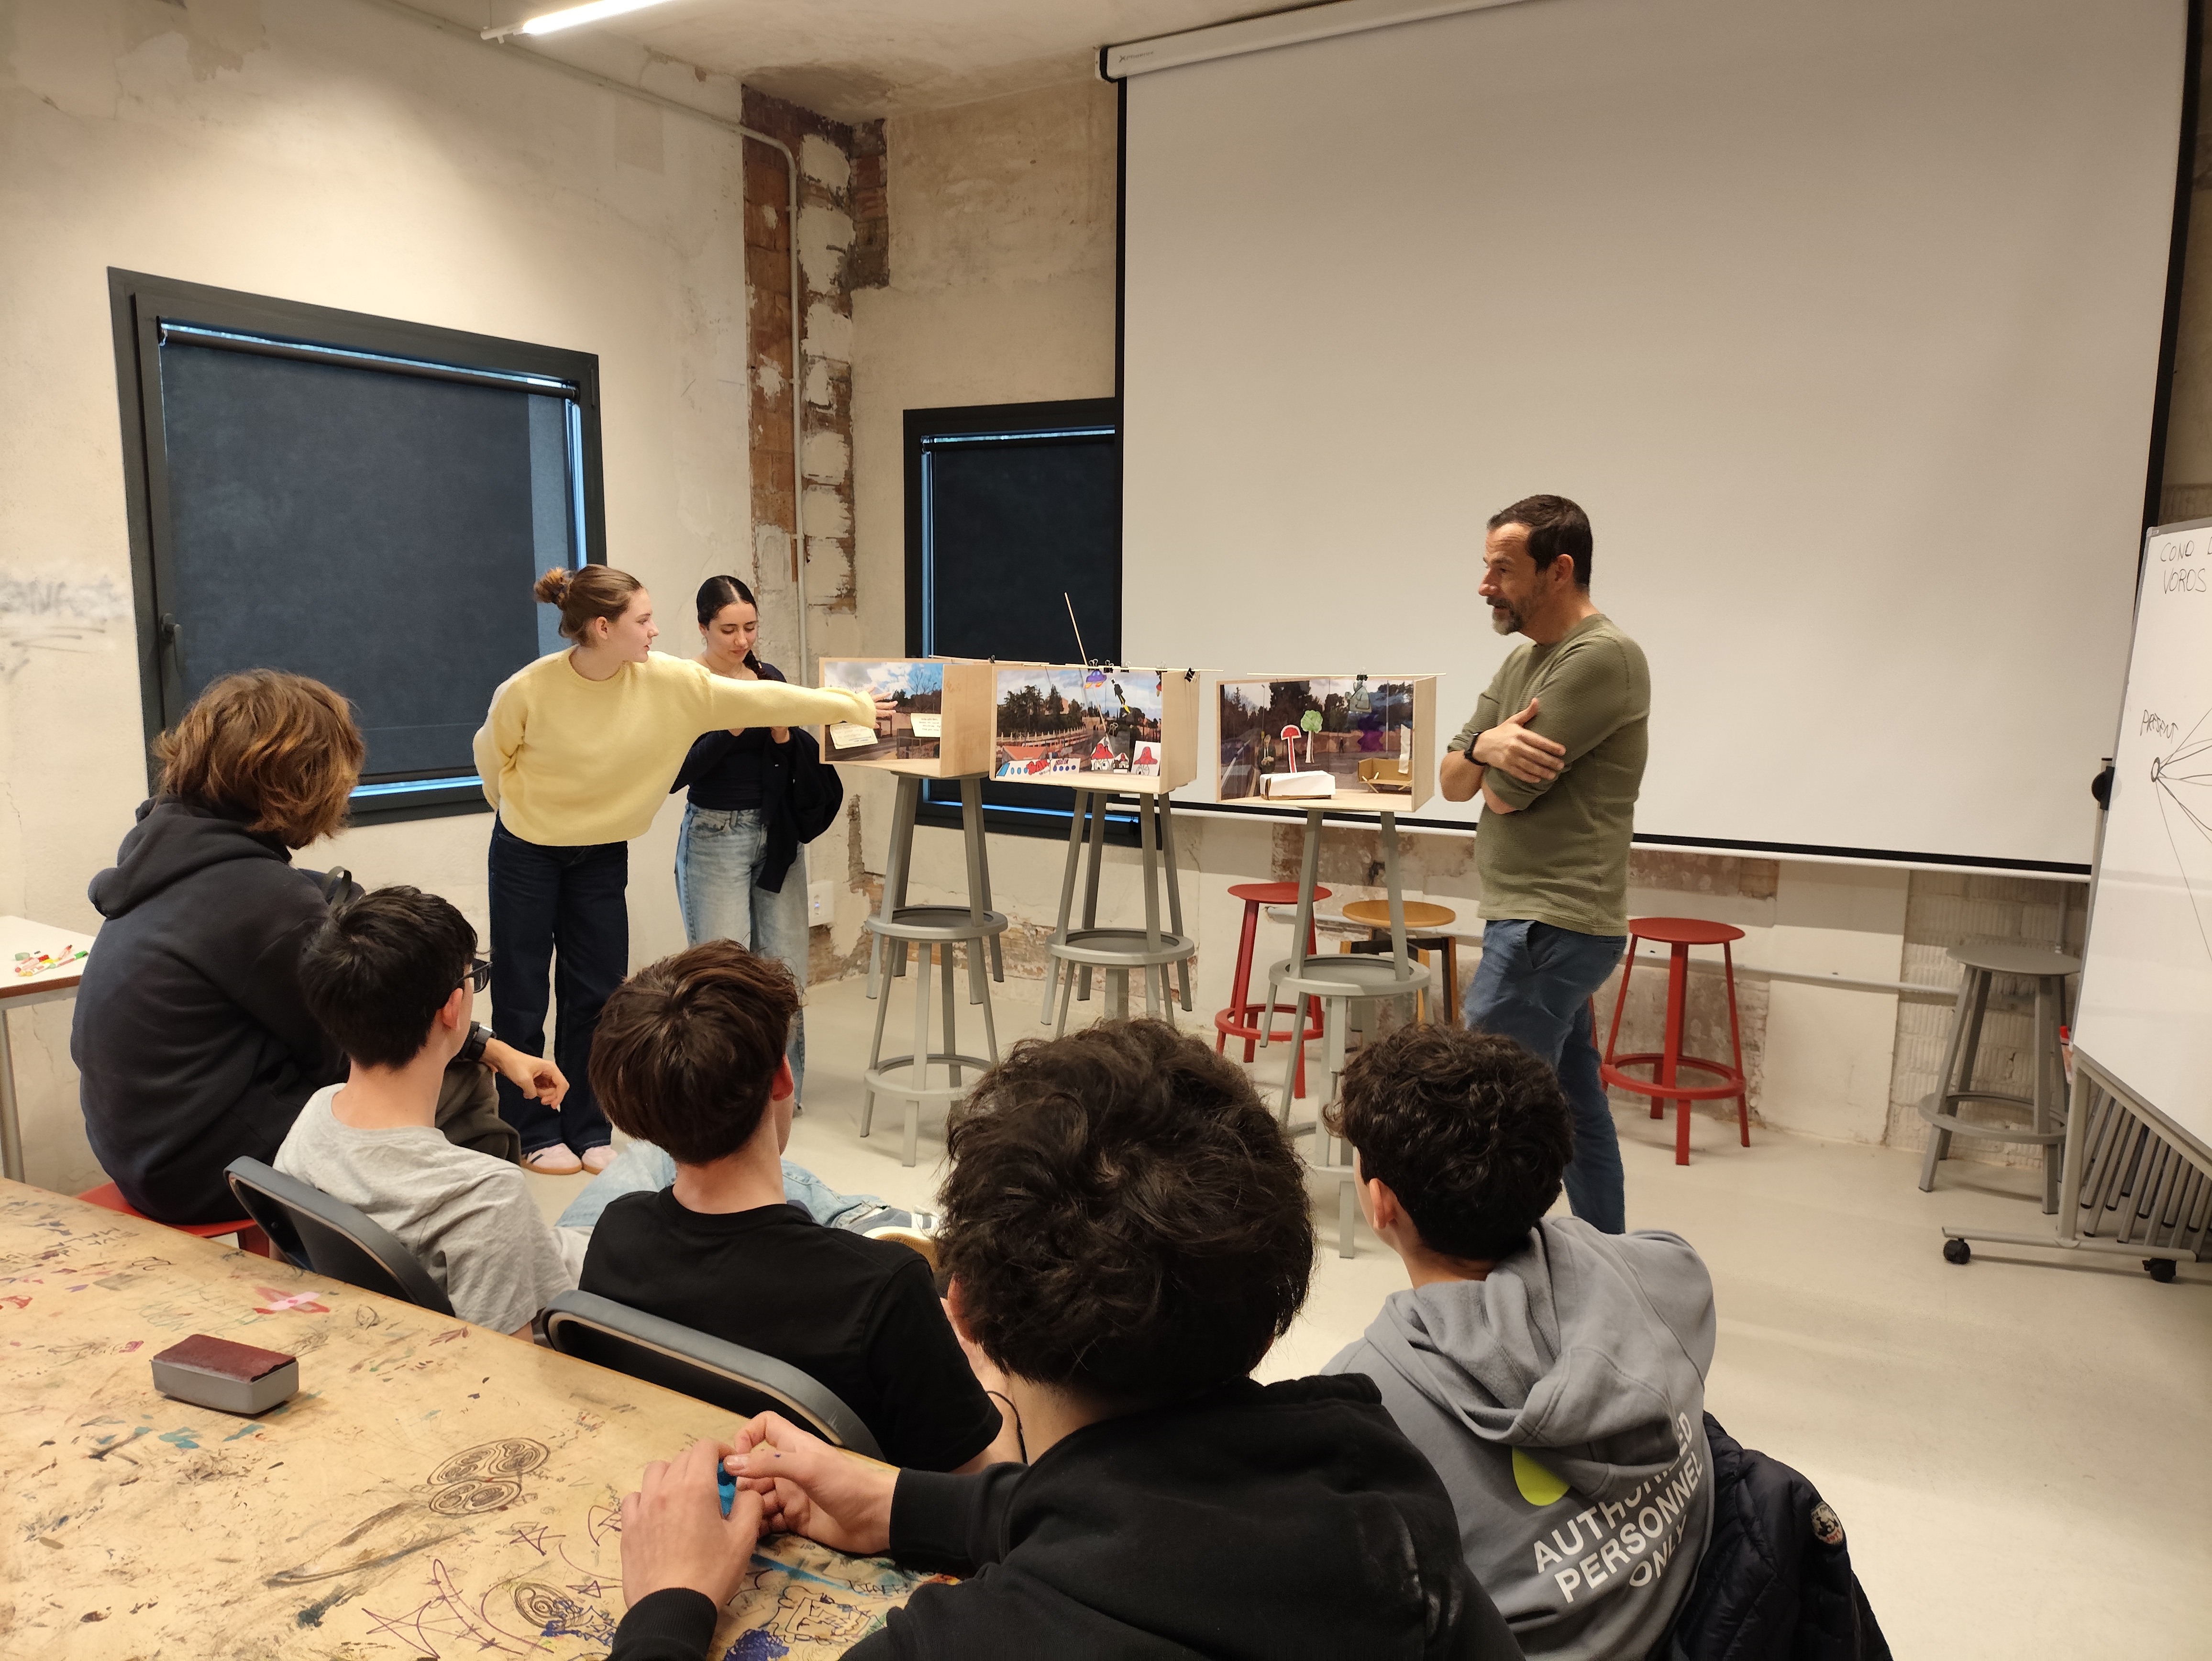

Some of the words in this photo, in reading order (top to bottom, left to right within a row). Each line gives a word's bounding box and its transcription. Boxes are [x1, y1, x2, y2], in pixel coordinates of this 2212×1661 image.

[2164, 568, 2206, 594] VOROS
[1555, 1451, 1703, 1603] PERSONNEL
[1629, 1513, 1687, 1587] ONLY
